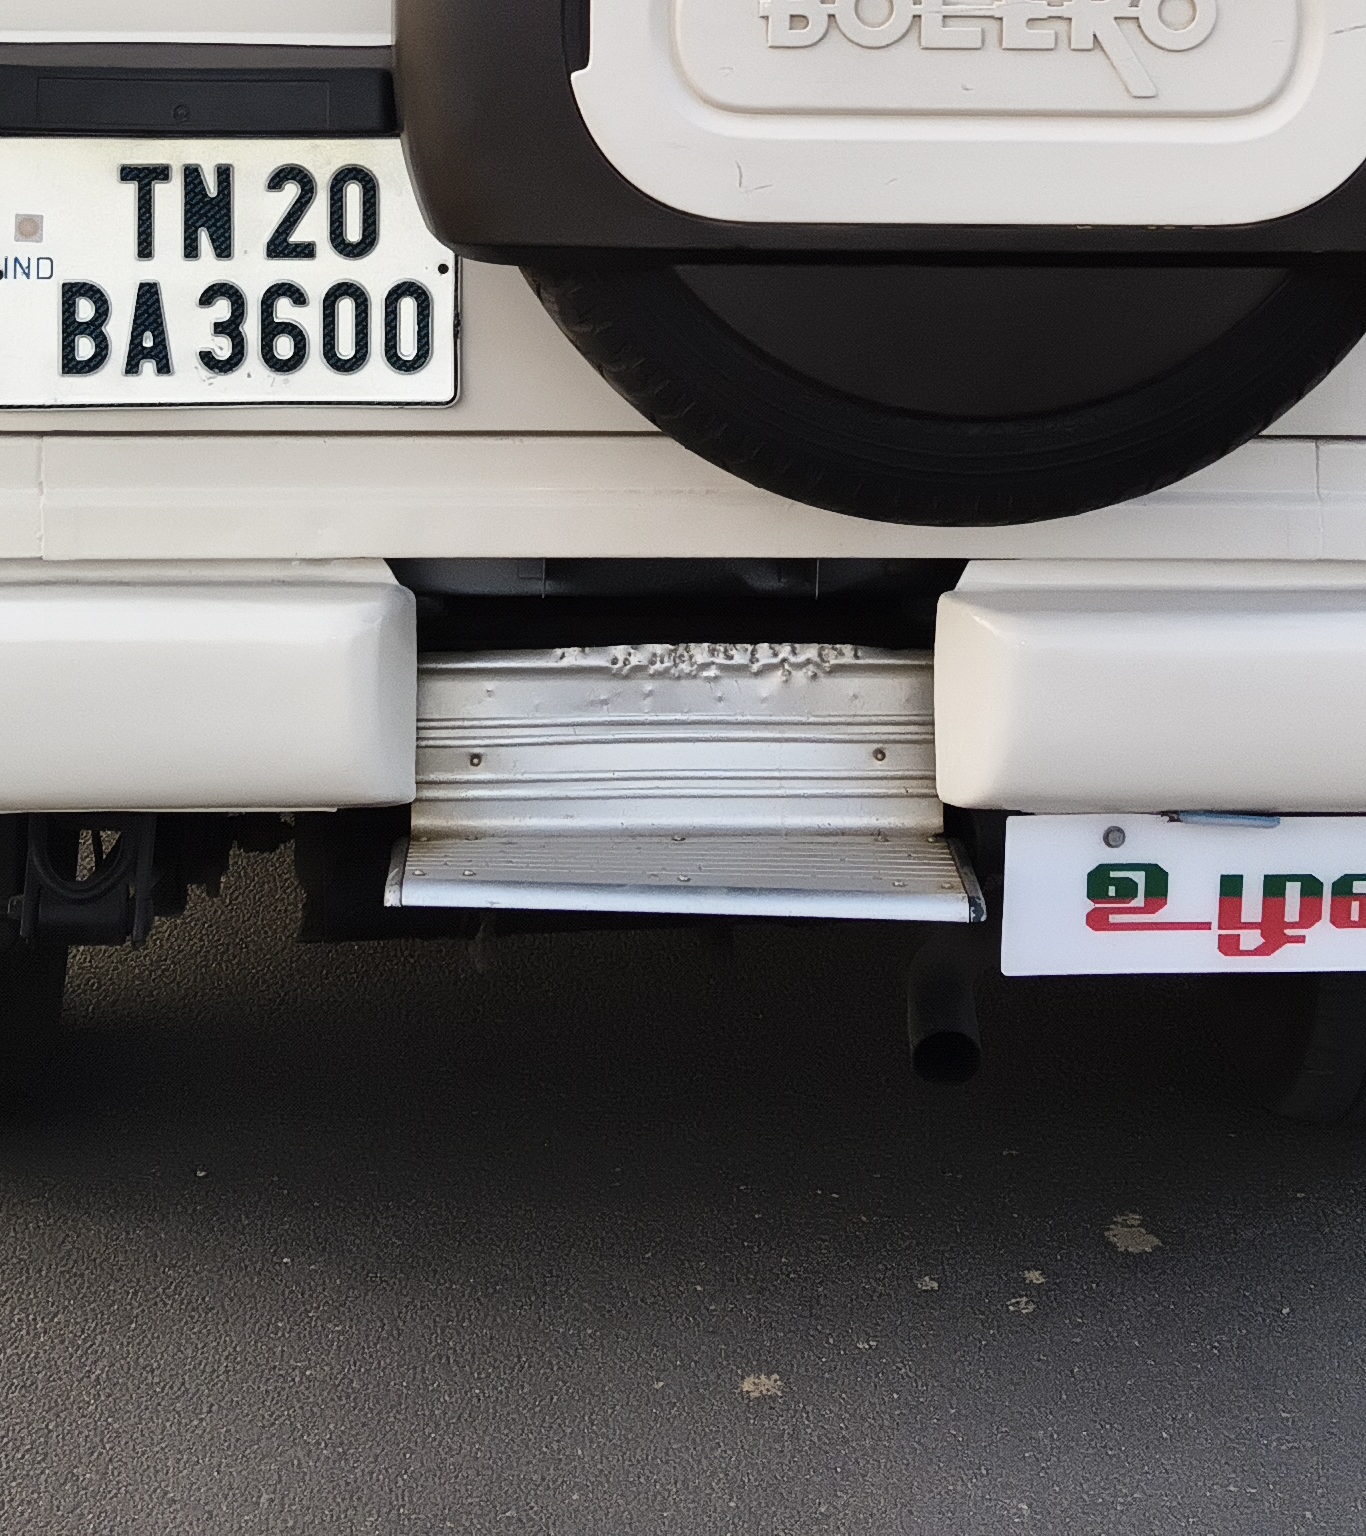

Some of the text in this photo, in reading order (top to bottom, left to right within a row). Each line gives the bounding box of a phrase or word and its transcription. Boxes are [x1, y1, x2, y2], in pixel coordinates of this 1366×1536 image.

[117, 163, 381, 261] TN 20
[3, 255, 55, 281] IND
[57, 279, 435, 377] BA 3600
